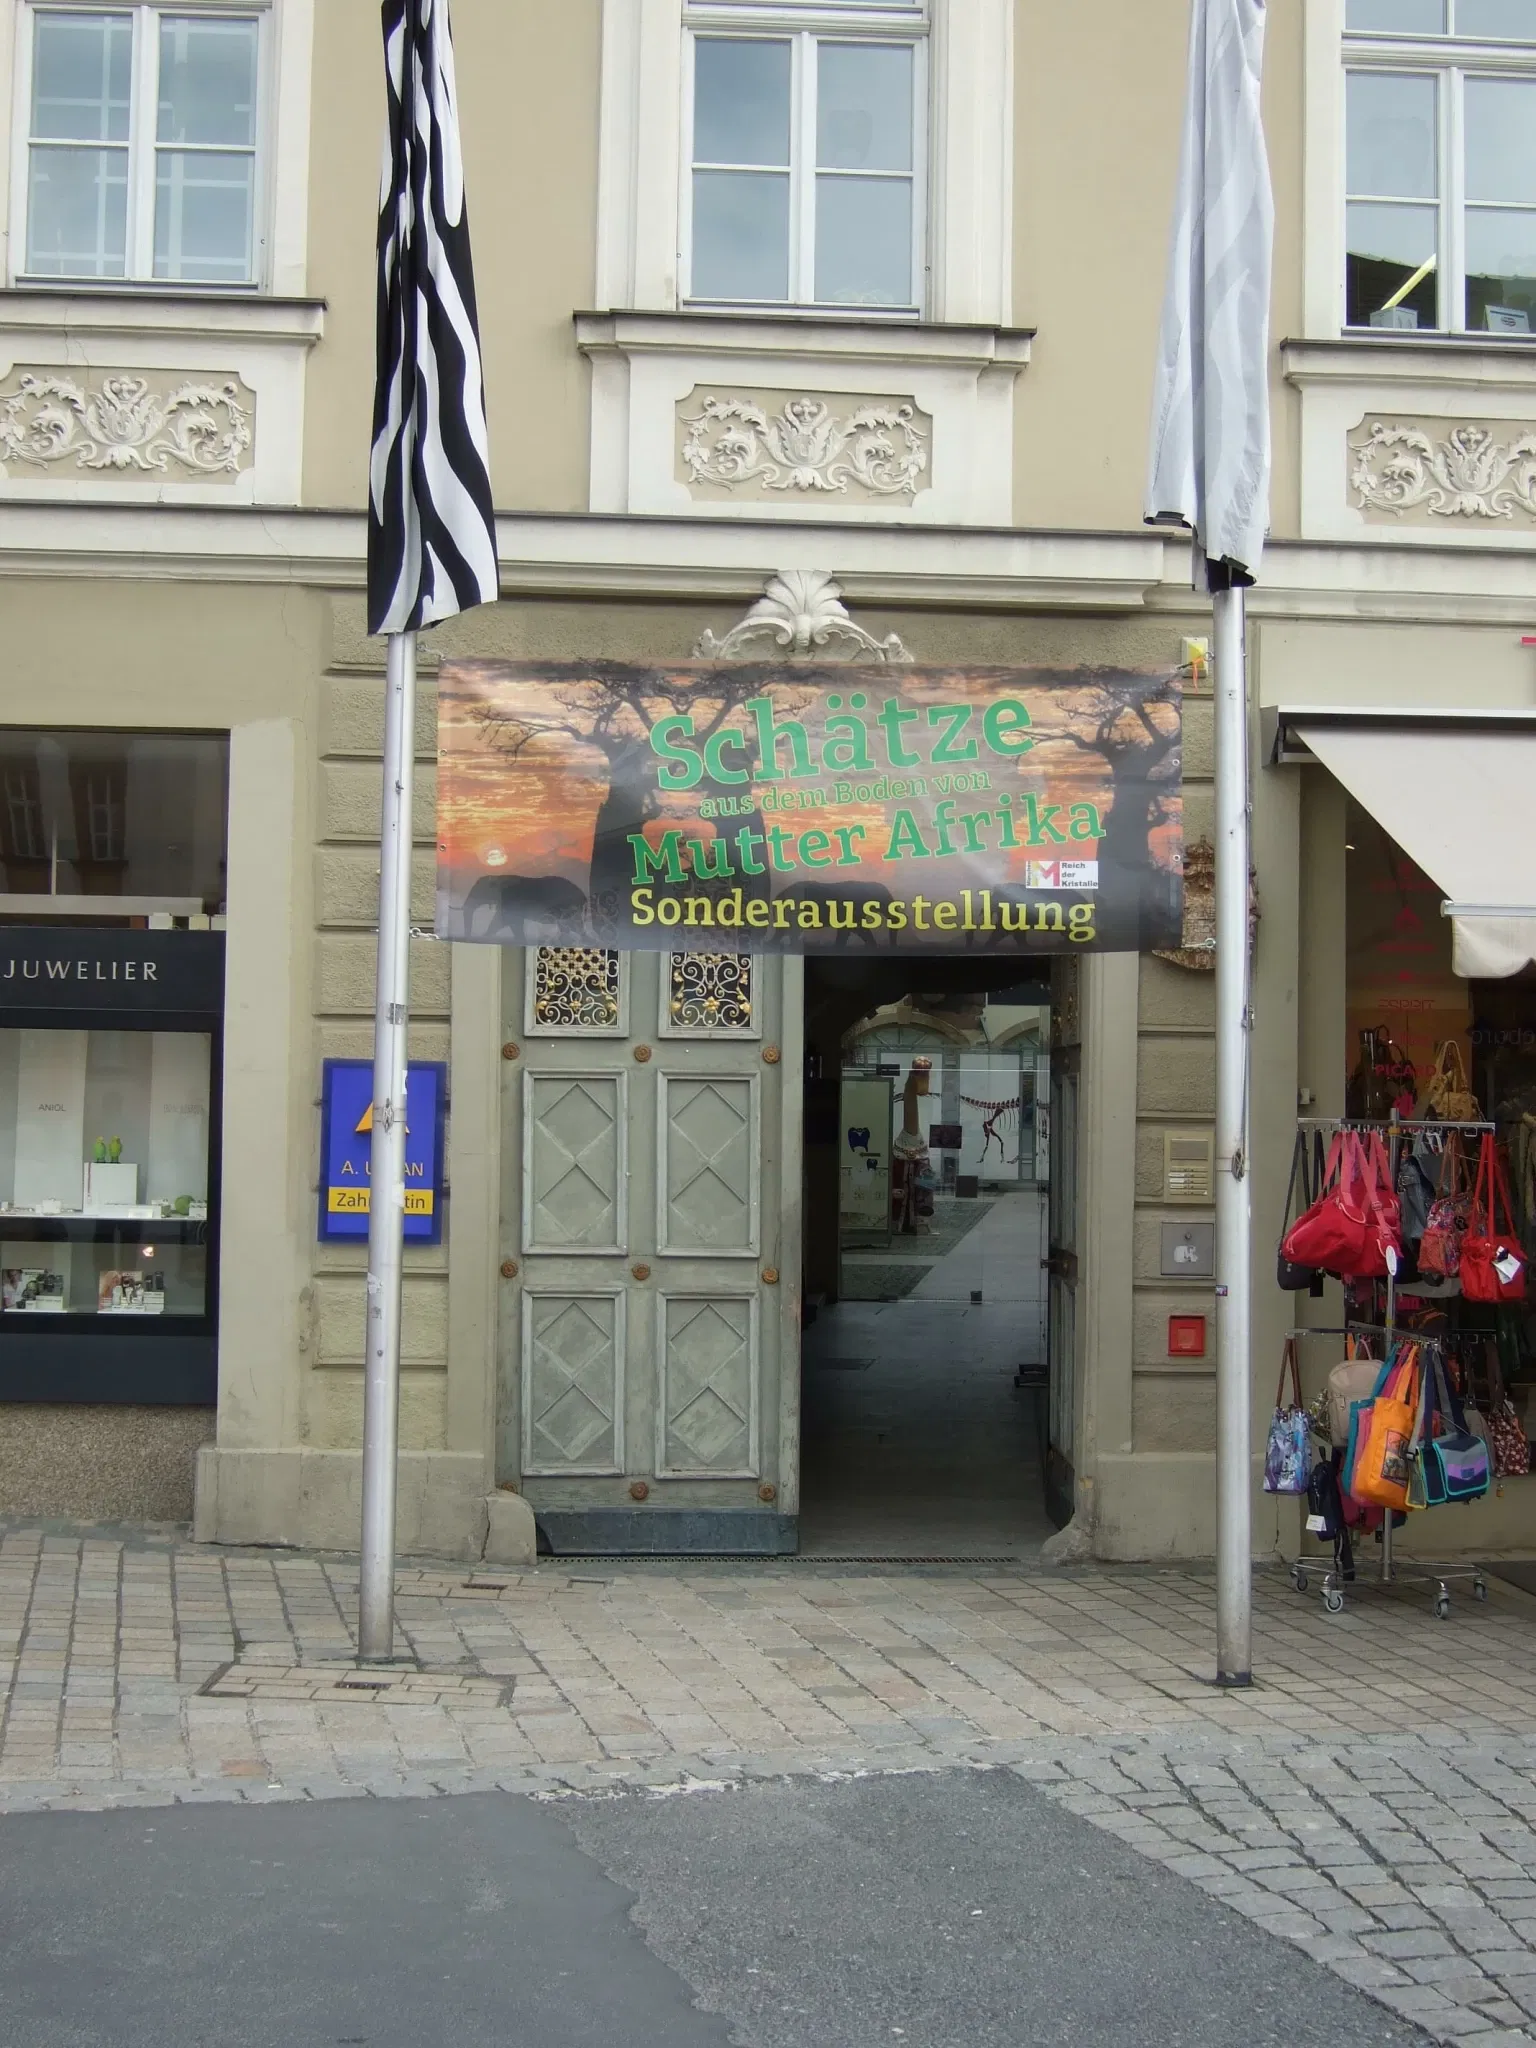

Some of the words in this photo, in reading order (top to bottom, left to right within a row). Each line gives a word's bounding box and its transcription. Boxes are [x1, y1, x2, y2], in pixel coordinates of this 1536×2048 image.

[650, 692, 1036, 790] Schätze
[700, 794, 755, 817] aus
[761, 786, 828, 812] dem
[834, 774, 928, 805] Boden
[932, 770, 992, 795] von
[627, 823, 867, 885] Mutter
[882, 792, 1107, 861] Afrika
[631, 887, 1096, 942] Sonderausstellung
[3, 960, 159, 981] JUWELIER
[341, 1160, 358, 1175] A.
